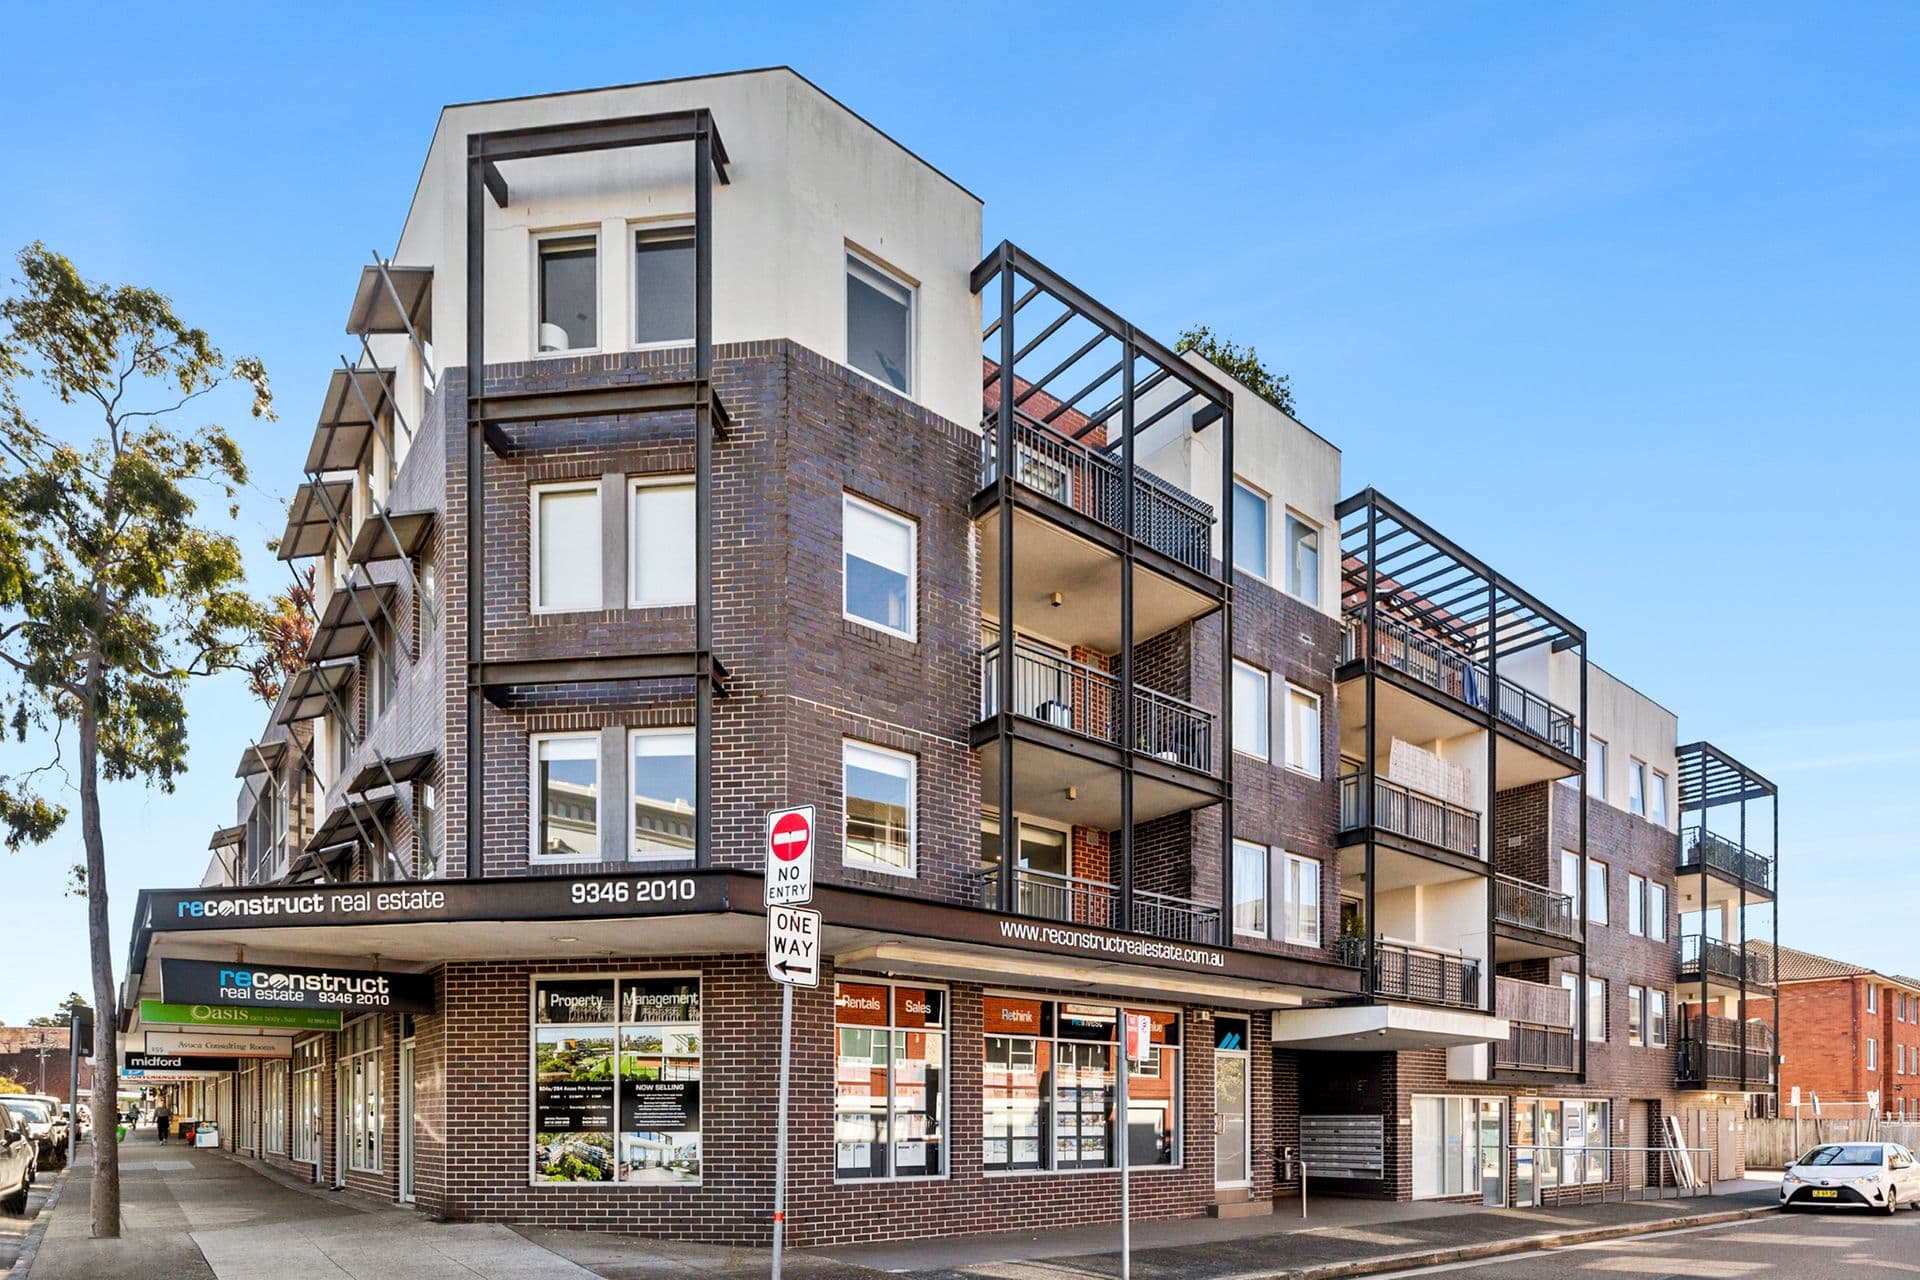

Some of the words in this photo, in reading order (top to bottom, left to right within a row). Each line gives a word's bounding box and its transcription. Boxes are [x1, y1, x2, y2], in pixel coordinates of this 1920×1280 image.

[778, 866, 800, 881] NO
[571, 882, 629, 904] 9346
[636, 878, 696, 902] 2010
[769, 884, 807, 899] ENTRY
[177, 892, 324, 918] reconstruct
[331, 891, 371, 912] real
[377, 888, 445, 911] estate
[777, 913, 812, 935] ONE
[774, 936, 813, 957] WAY
[1000, 920, 1224, 967] www.reconstructrealestate.com.au
[220, 969, 389, 994] reconstruct
[220, 987, 251, 999] real
[255, 989, 304, 1002] estate
[318, 991, 352, 1004] 9346
[356, 994, 390, 1006] 2010
[551, 993, 603, 1011] Property
[623, 992, 699, 1009] Management
[842, 995, 880, 1010] Rentals
[191, 1005, 249, 1020] Oasis
[905, 1000, 932, 1014] Sales
[1001, 1008, 1033, 1023] Rethink
[178, 1040, 203, 1049] Avoca
[205, 1041, 246, 1051] Consulting
[249, 1043, 276, 1052] Rooms
[131, 1057, 182, 1067] midford
